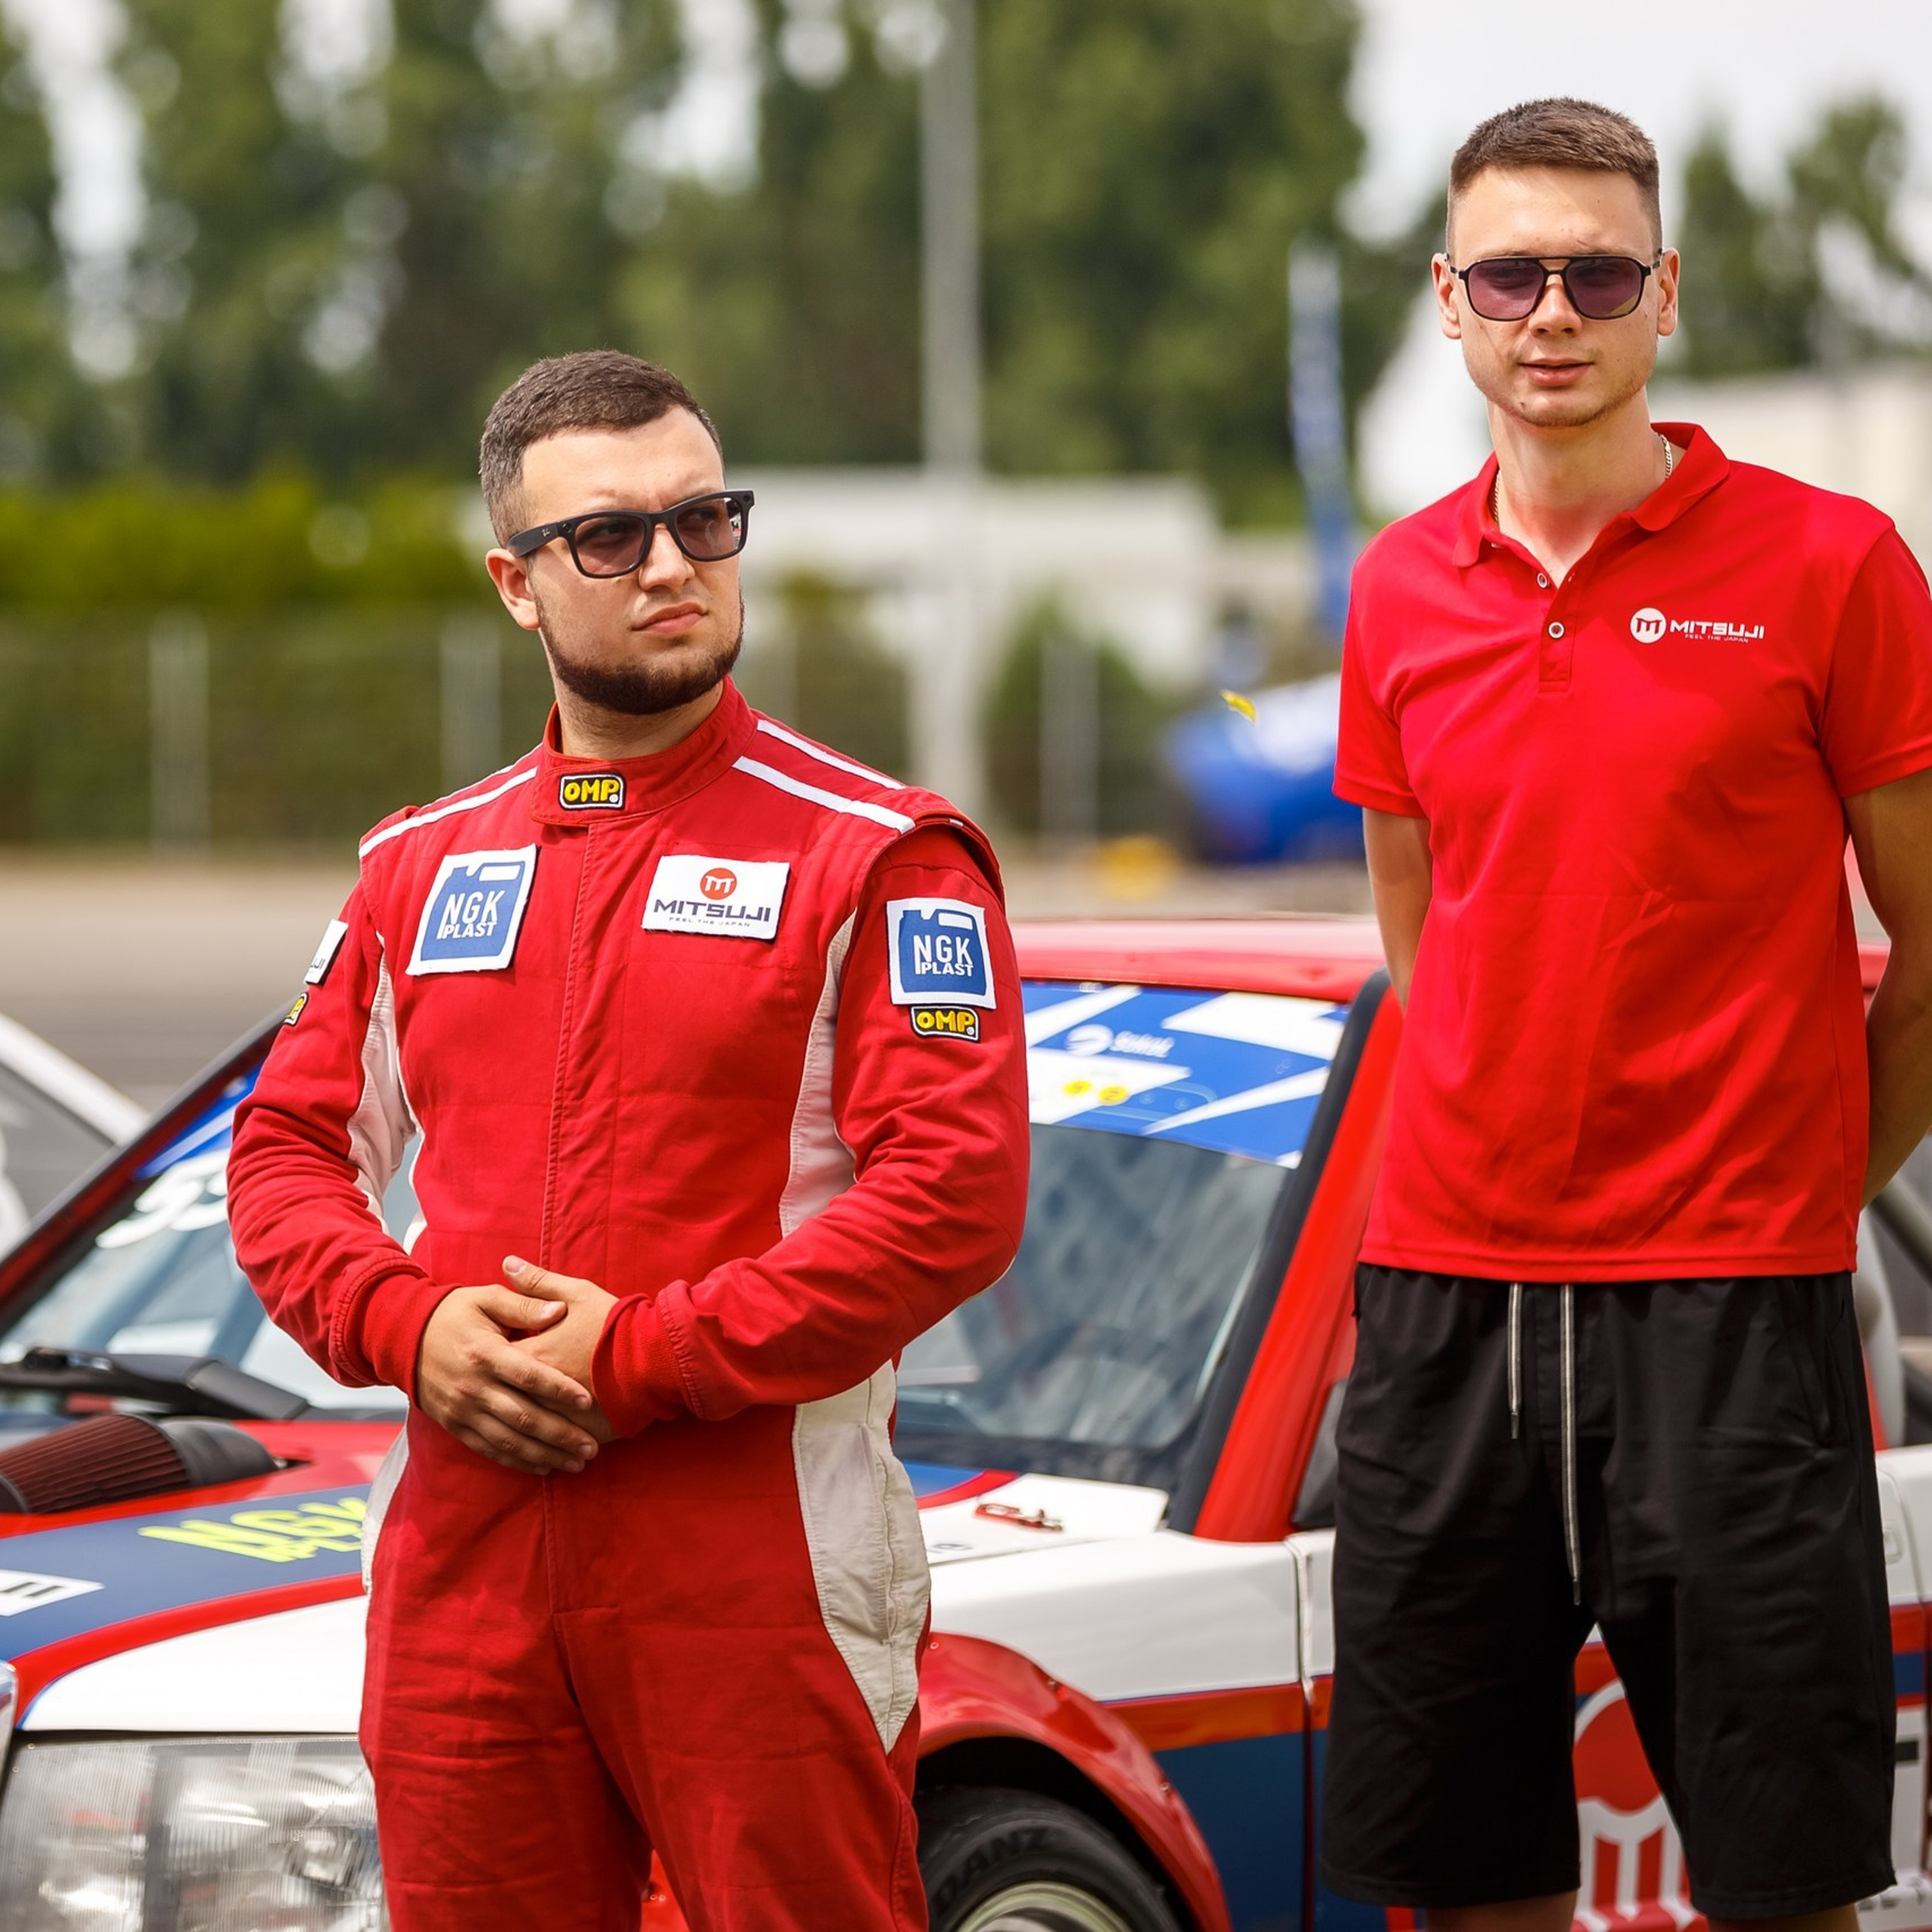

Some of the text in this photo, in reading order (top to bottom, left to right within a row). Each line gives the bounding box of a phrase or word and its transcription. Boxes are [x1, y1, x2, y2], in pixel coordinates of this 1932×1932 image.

[1669, 619, 1764, 639] MITSUJI
[436, 890, 506, 940] NGK
[653, 899, 771, 922] MITSUJI
[442, 921, 497, 940] PLAST
[913, 934, 973, 975] NGK
[921, 961, 974, 977] PLAST
